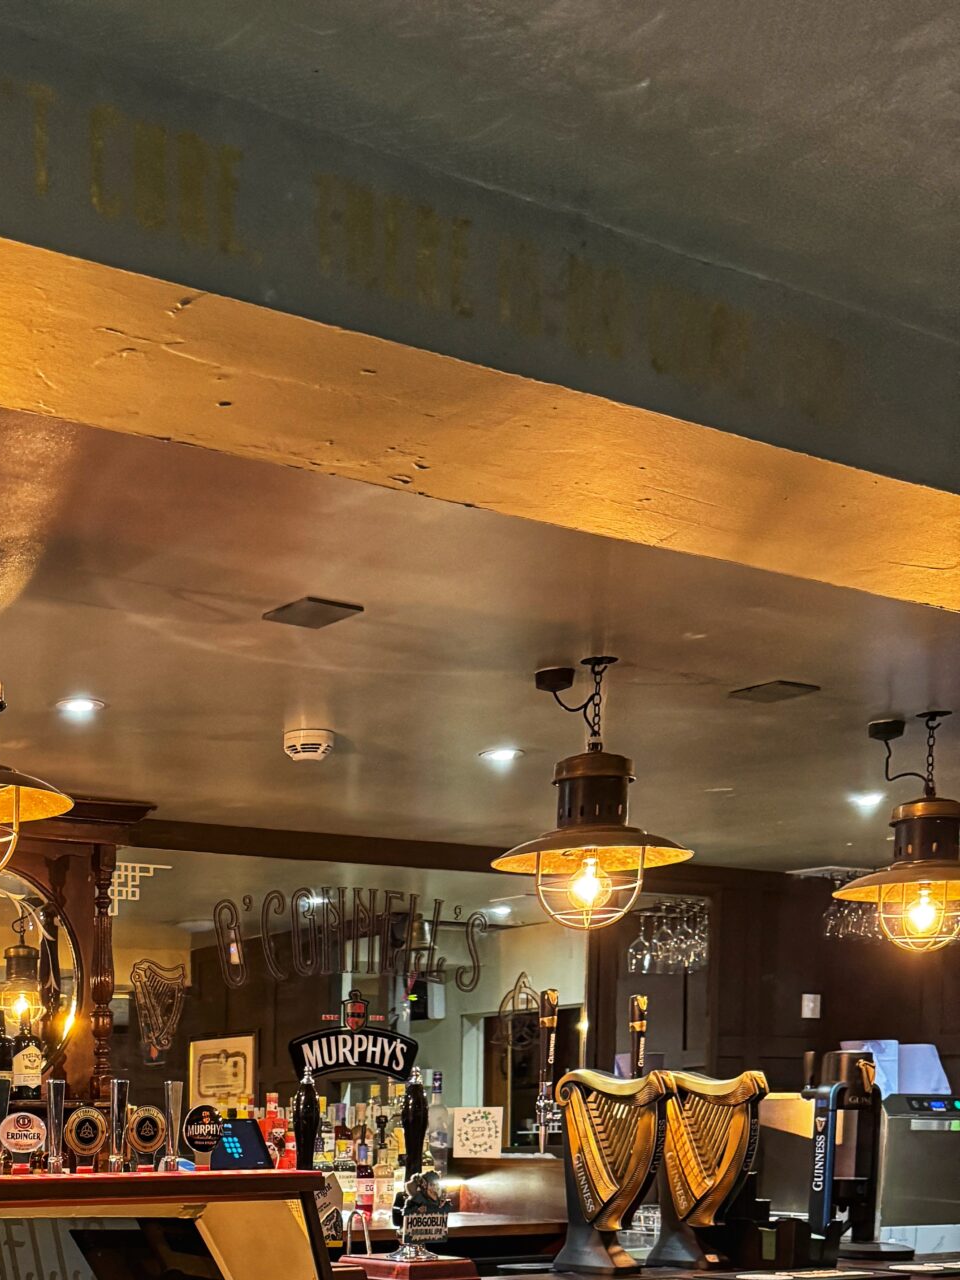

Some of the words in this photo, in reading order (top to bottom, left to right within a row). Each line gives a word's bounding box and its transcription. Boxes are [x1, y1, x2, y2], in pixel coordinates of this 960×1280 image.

[213, 886, 489, 992] O'CONNELL'S
[301, 1034, 407, 1071] MURPHY'S
[6, 1132, 41, 1140] ERDINGER
[812, 1134, 826, 1192] GUINNESS
[574, 1152, 595, 1214] GUINNESS
[666, 1152, 688, 1209] GUINNESS
[407, 1216, 448, 1229] HOBGOBLIN
